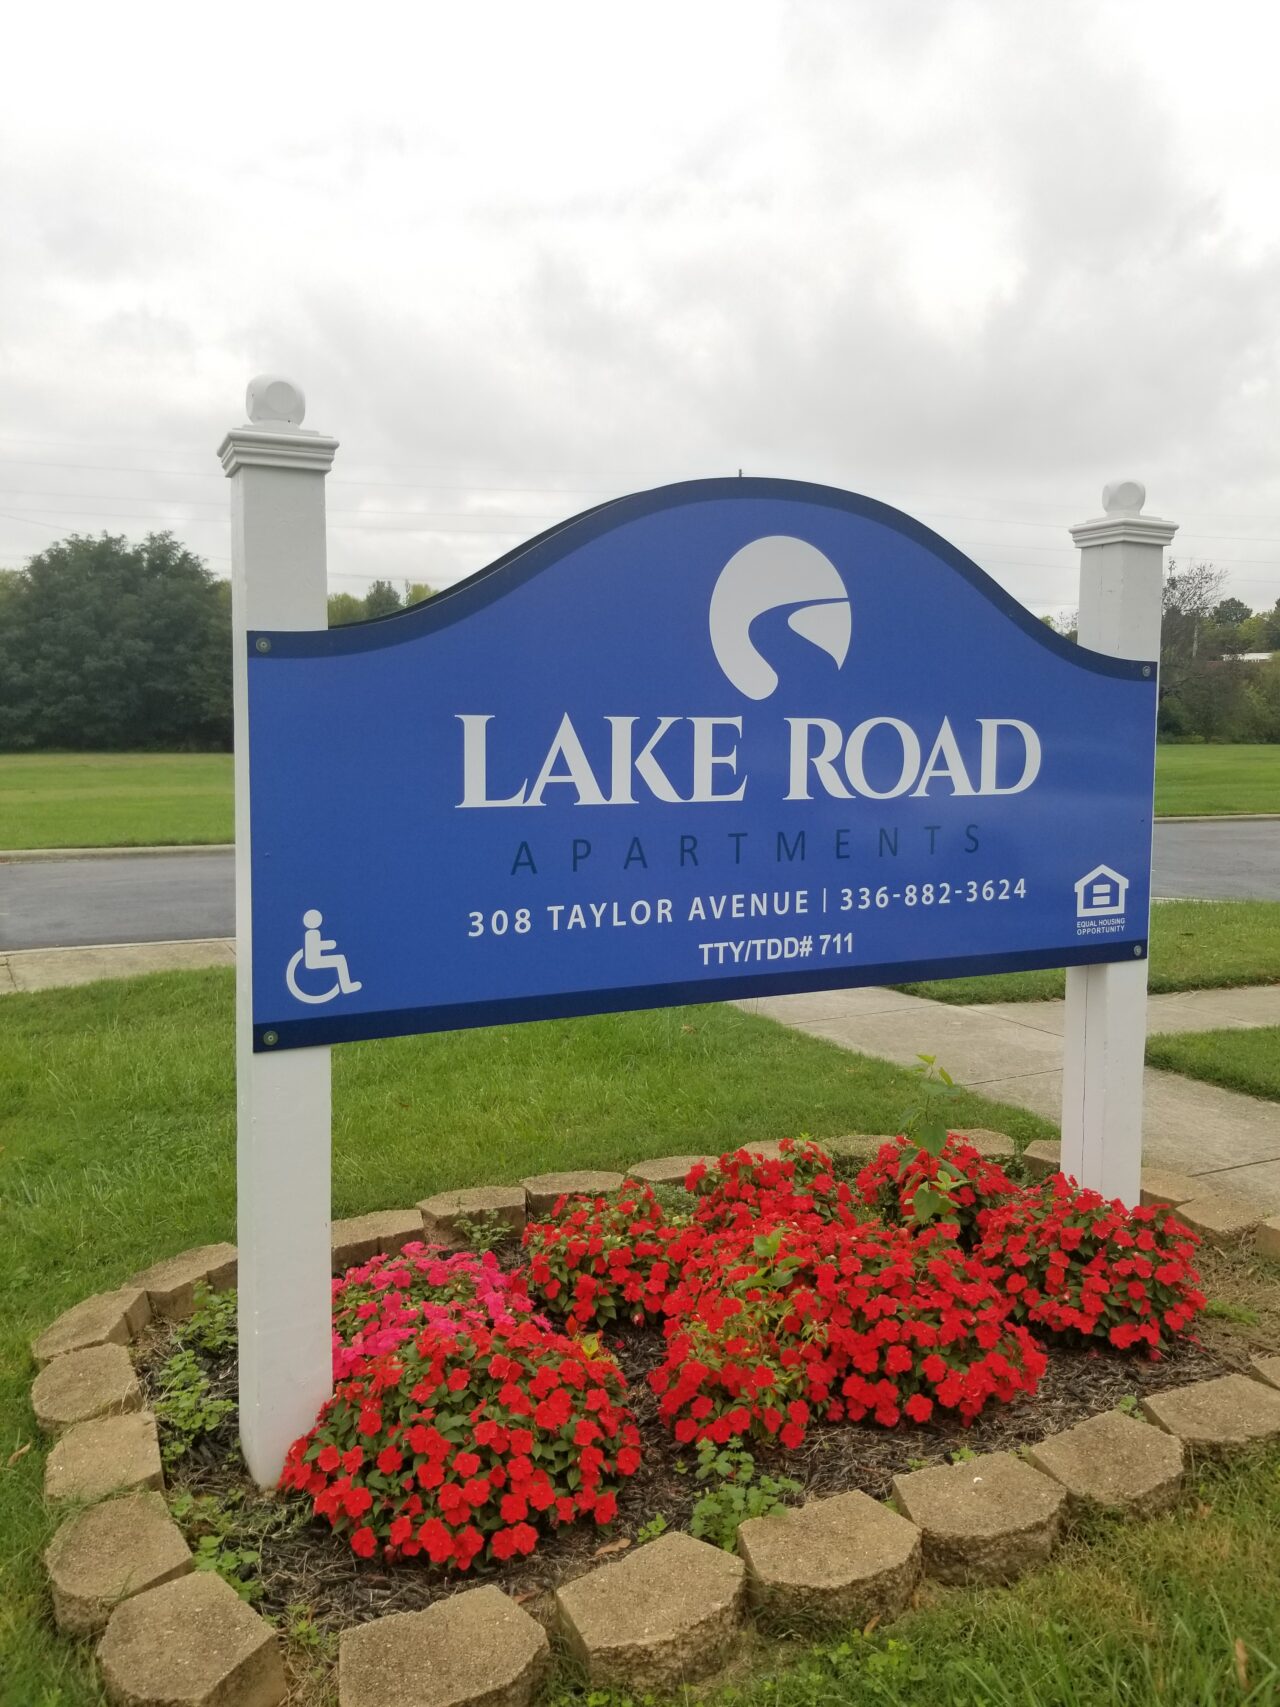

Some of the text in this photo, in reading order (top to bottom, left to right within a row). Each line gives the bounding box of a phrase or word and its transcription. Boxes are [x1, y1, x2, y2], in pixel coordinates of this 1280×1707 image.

[454, 711, 1043, 809] LAKE ROAD
[510, 823, 981, 876] APARTMENTS
[467, 907, 533, 938] 308
[547, 899, 674, 932] TAYLOR
[688, 889, 809, 922] AVENUE
[839, 878, 1028, 911] 336-882-3624
[1077, 918, 1125, 928] EQUAL HOUSING
[698, 932, 855, 966] TTY/TDD# 711
[1077, 925, 1125, 935] OPPORTUNITY
